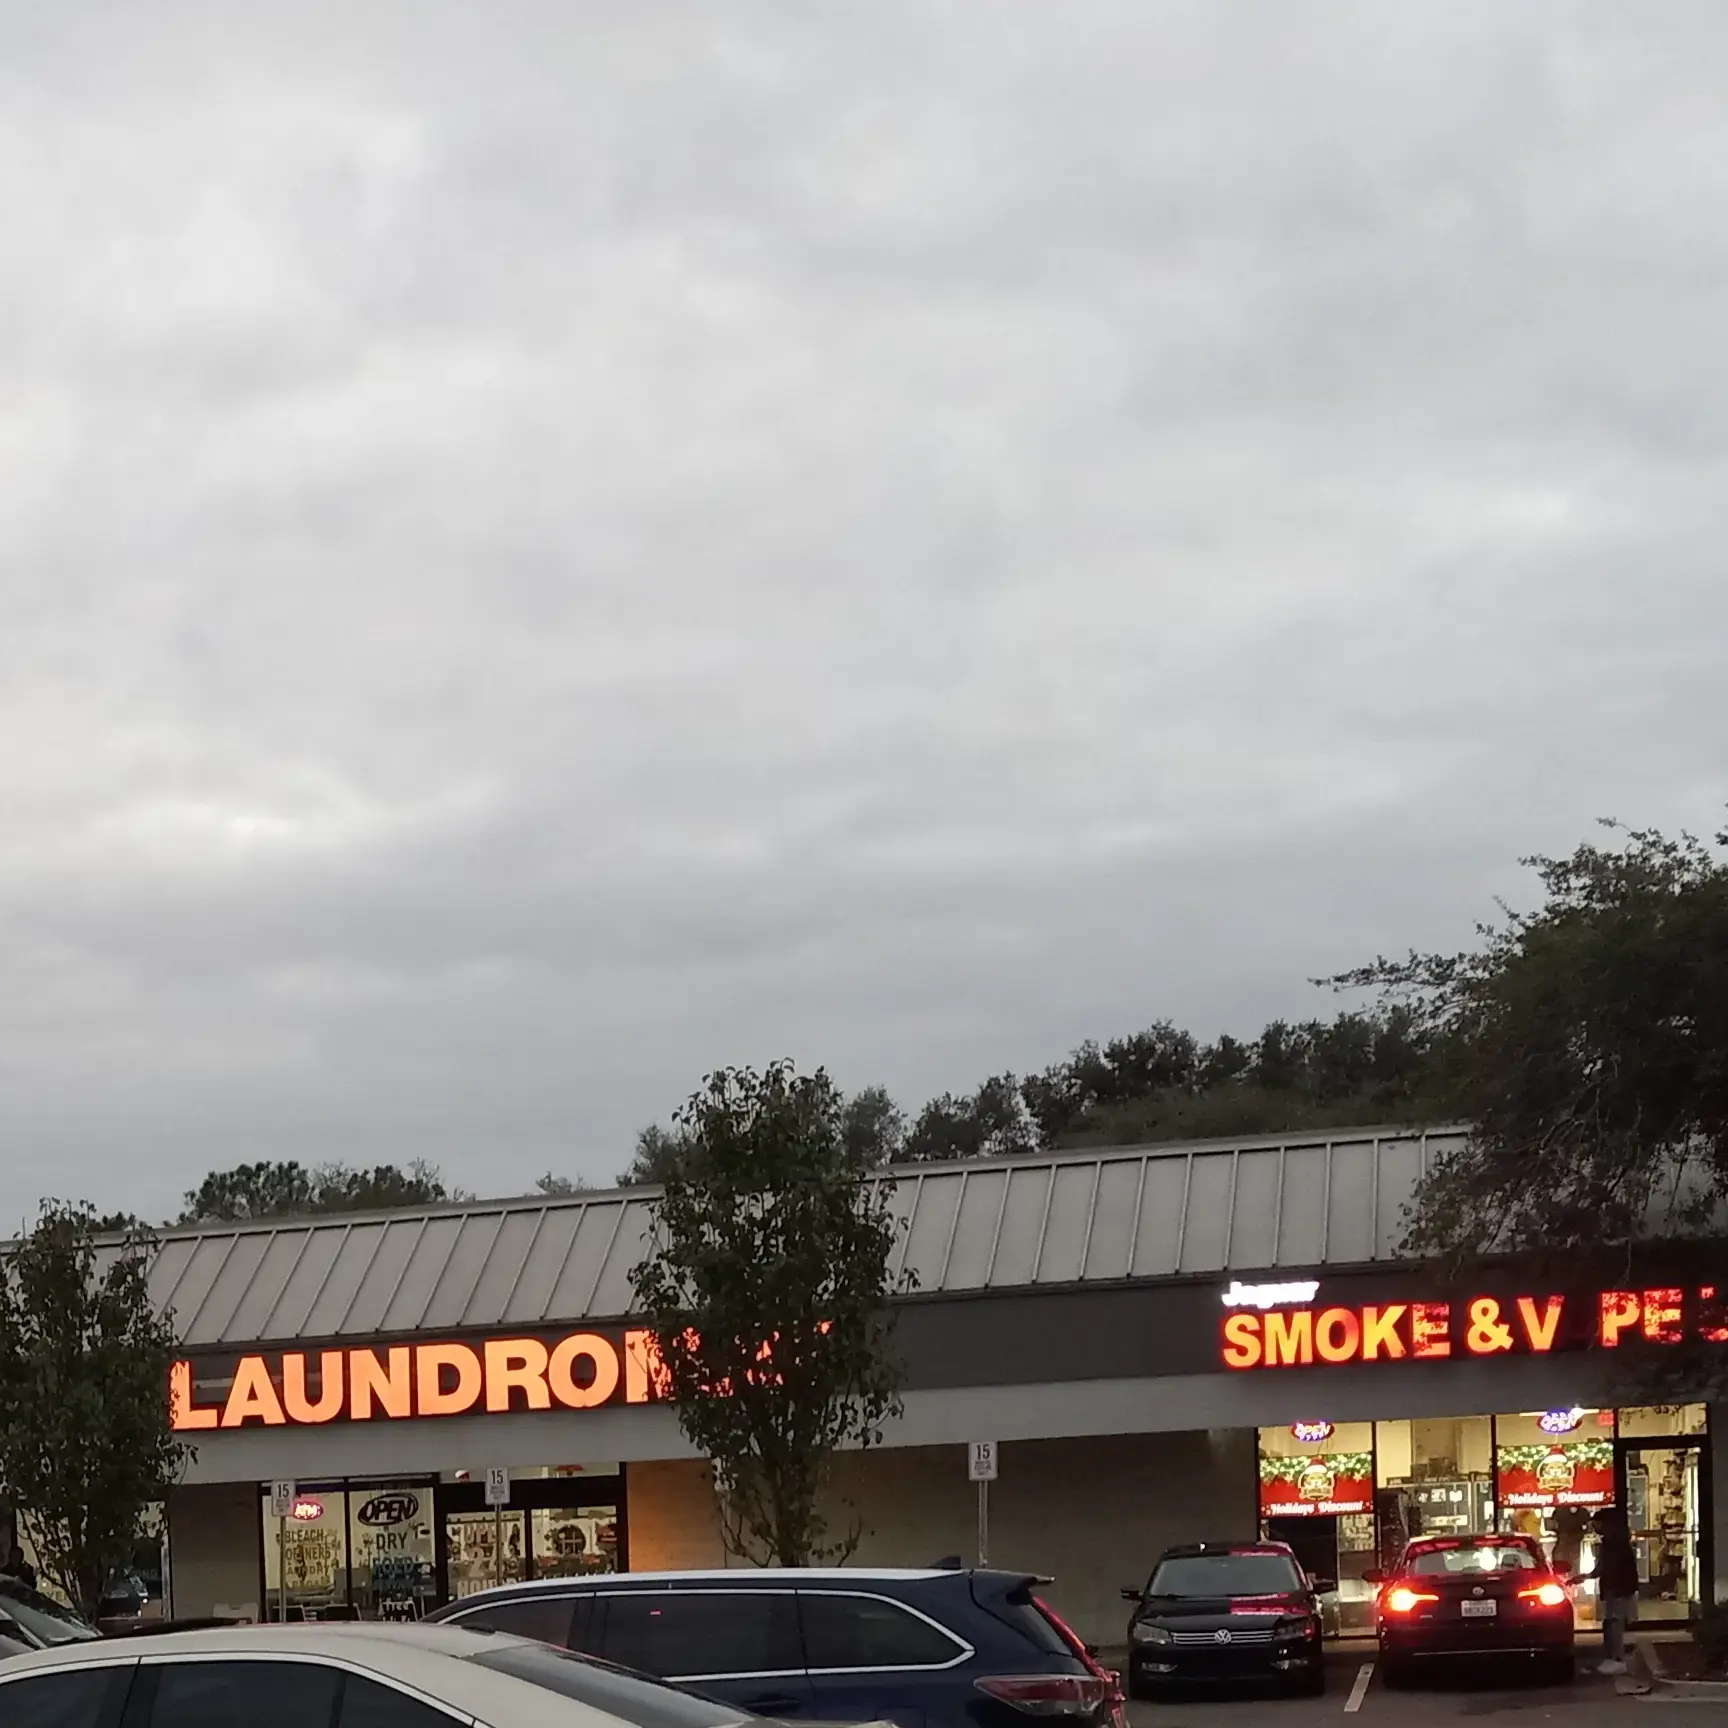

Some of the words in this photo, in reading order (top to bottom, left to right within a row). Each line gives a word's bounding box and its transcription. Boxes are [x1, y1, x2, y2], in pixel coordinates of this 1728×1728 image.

[1222, 1302, 1452, 1369] SMOKE
[1466, 1297, 1513, 1355] &
[975, 1444, 990, 1460] 15
[491, 1470, 504, 1485] 15
[277, 1483, 290, 1498] 15
[1508, 1492, 1554, 1506] Holidays
[1558, 1490, 1604, 1503] Discount
[364, 1497, 413, 1523] OPEN
[1269, 1502, 1315, 1517] Holidays
[1318, 1500, 1364, 1513] Discount
[285, 1529, 324, 1543] BLEACH
[376, 1532, 408, 1550] DRY
